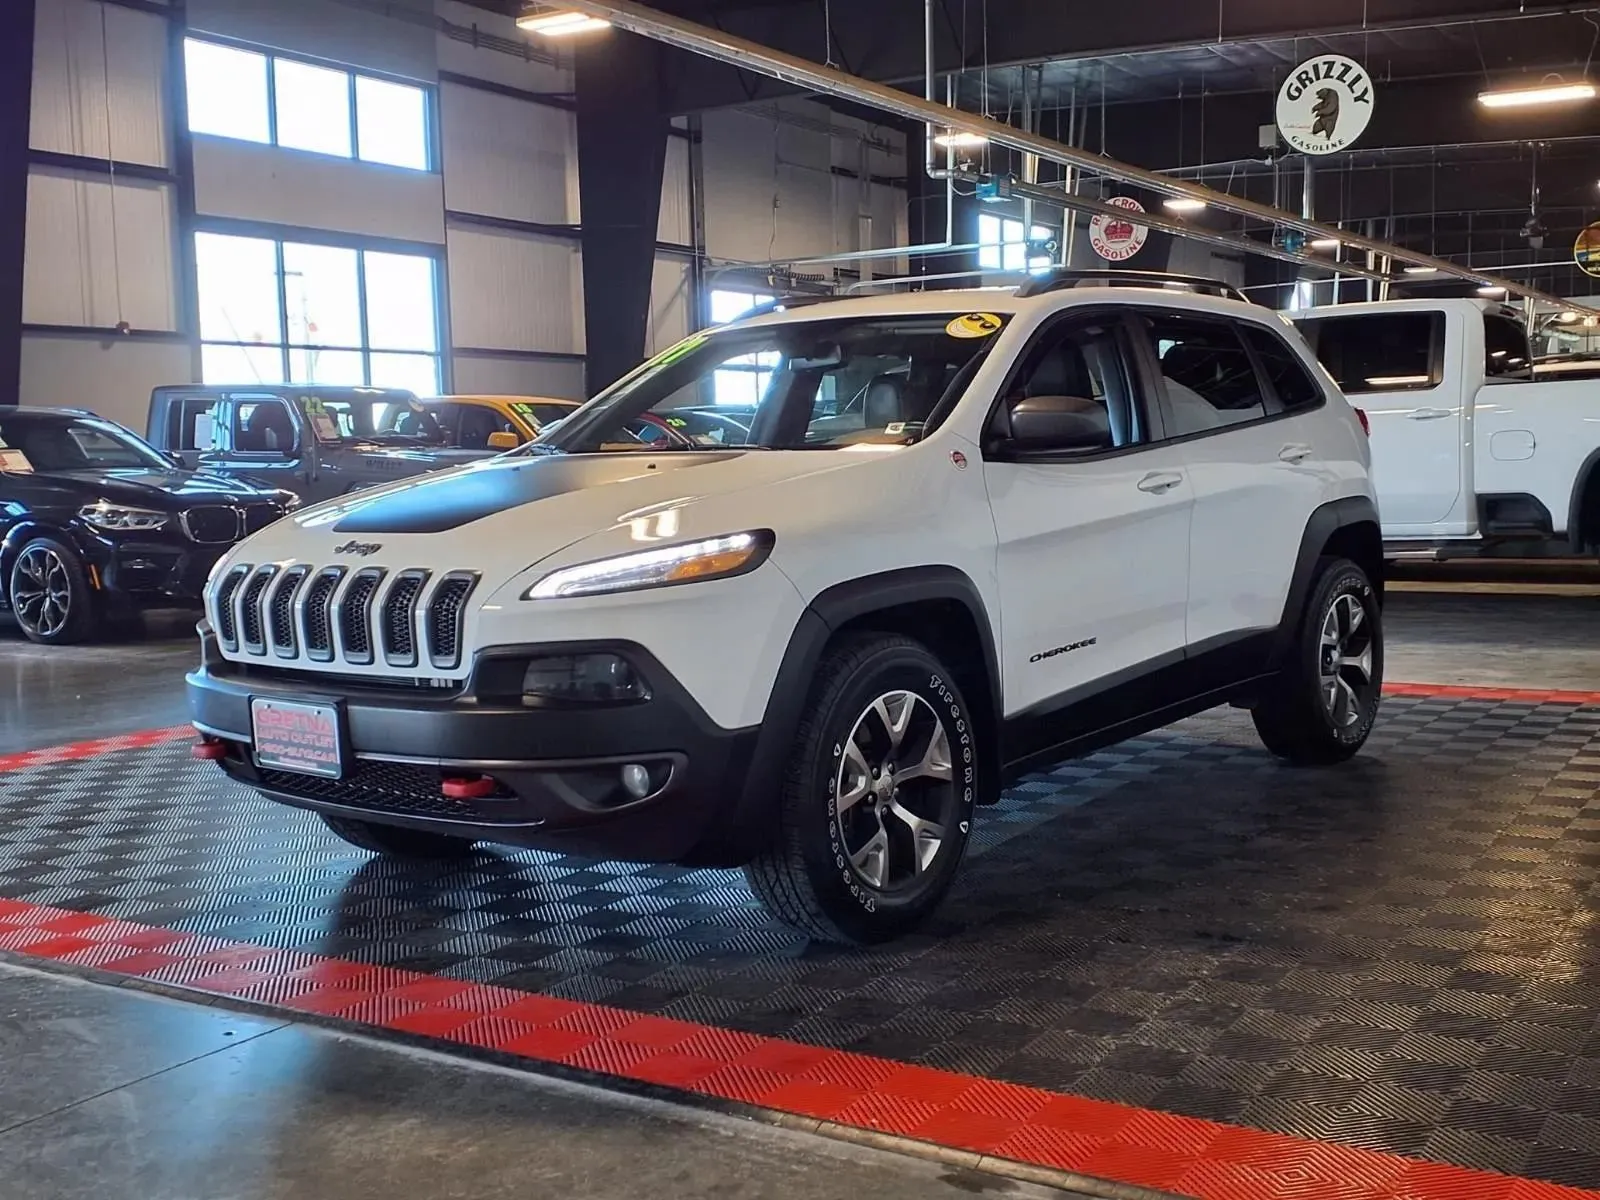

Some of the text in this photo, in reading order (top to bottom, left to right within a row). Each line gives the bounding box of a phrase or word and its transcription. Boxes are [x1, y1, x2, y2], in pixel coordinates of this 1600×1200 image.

[1286, 60, 1369, 104] GRIZZLY
[1291, 135, 1345, 151] GASOLINE
[1093, 236, 1142, 259] GASOLINE
[1029, 637, 1097, 663] CHEROKEE
